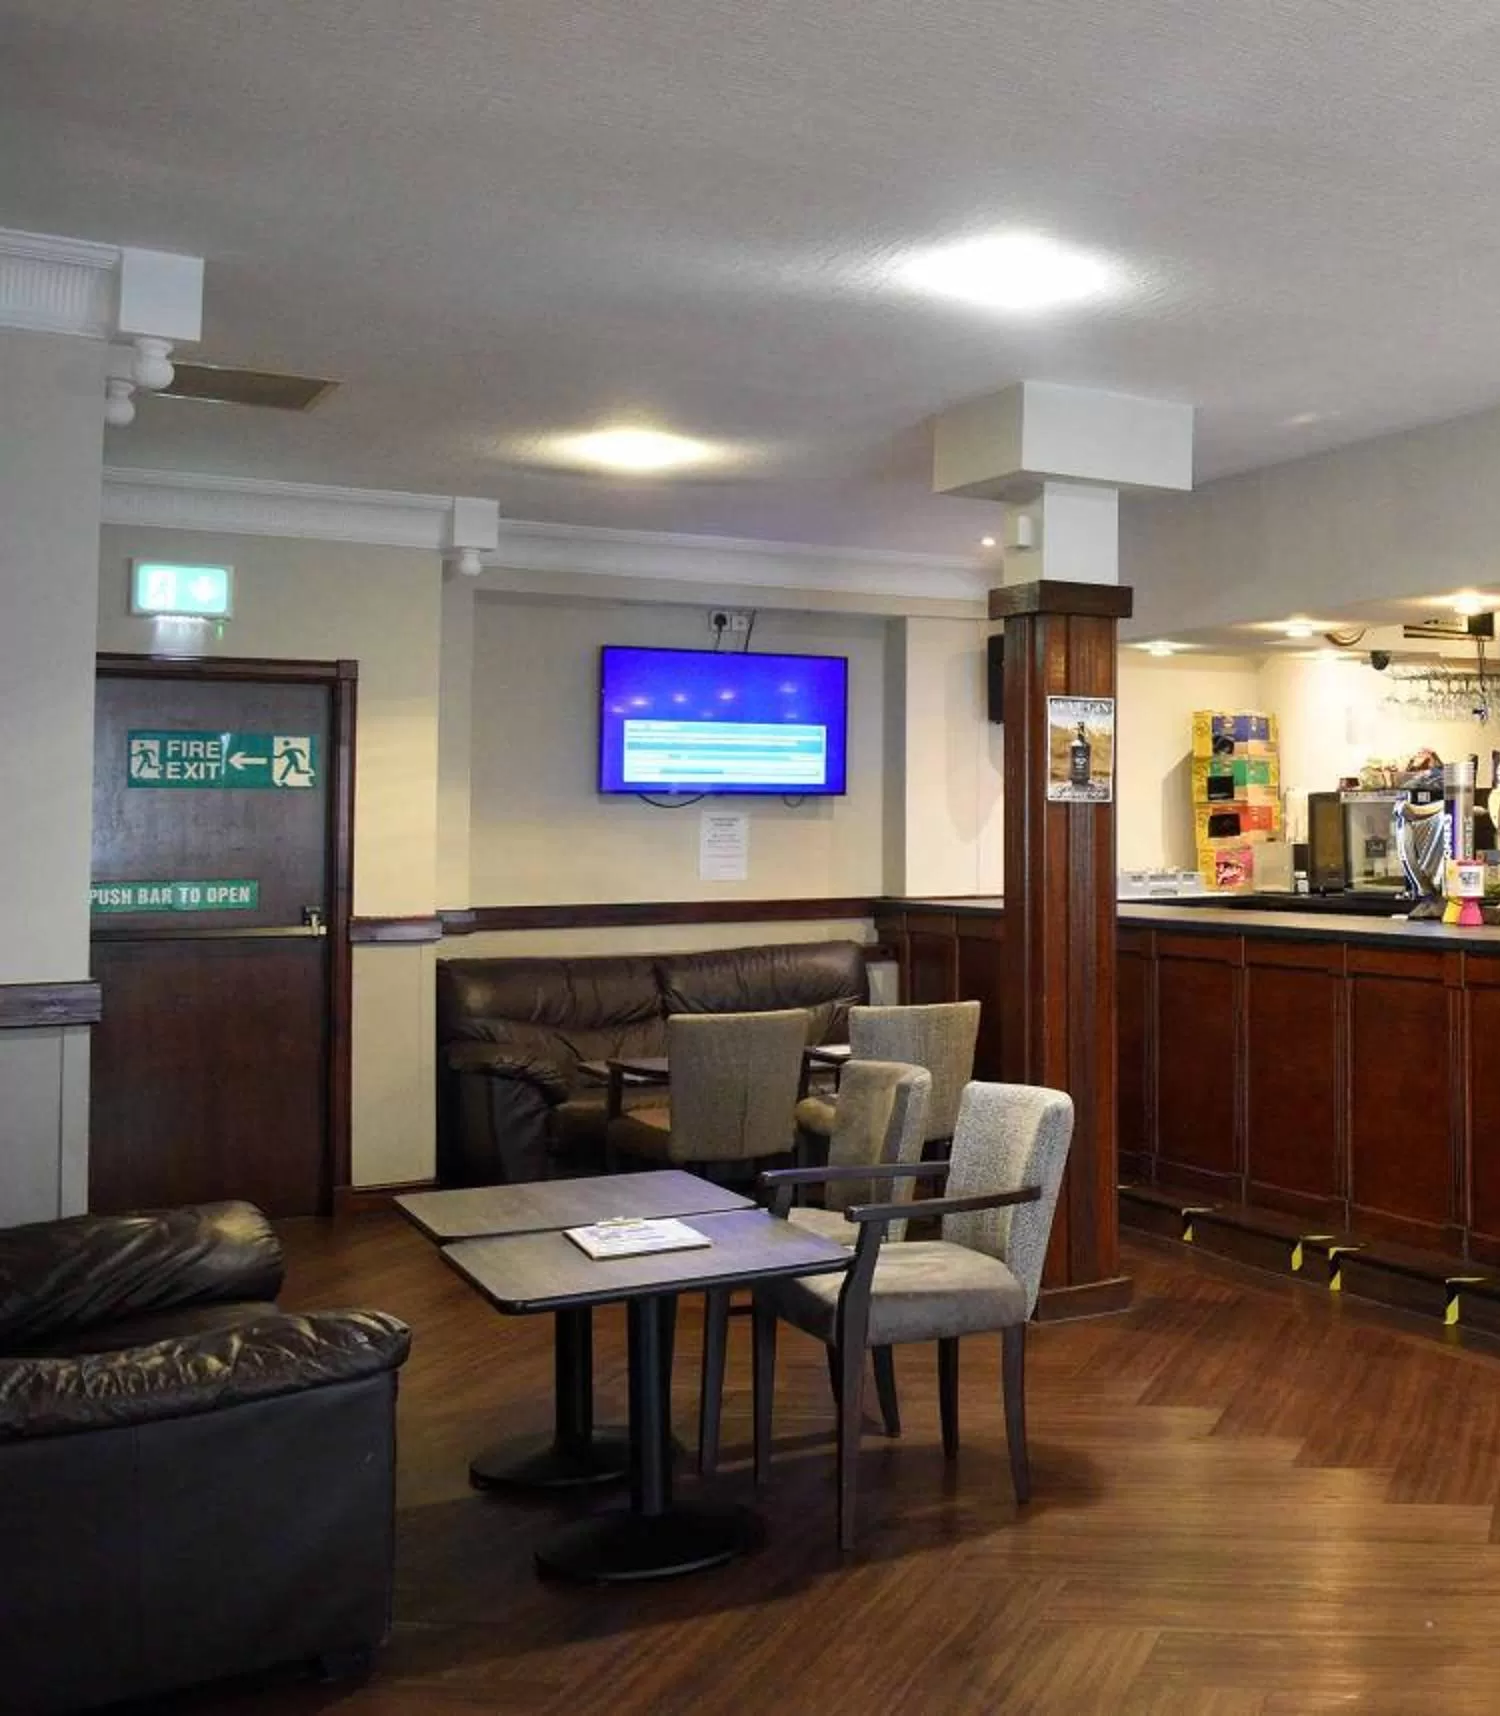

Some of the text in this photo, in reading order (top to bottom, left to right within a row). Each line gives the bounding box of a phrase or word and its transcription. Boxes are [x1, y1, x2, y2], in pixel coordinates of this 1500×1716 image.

[167, 740, 221, 758] FIRE
[167, 761, 221, 779] EXIT
[89, 886, 250, 905] PUSH BAR TO OPEN
